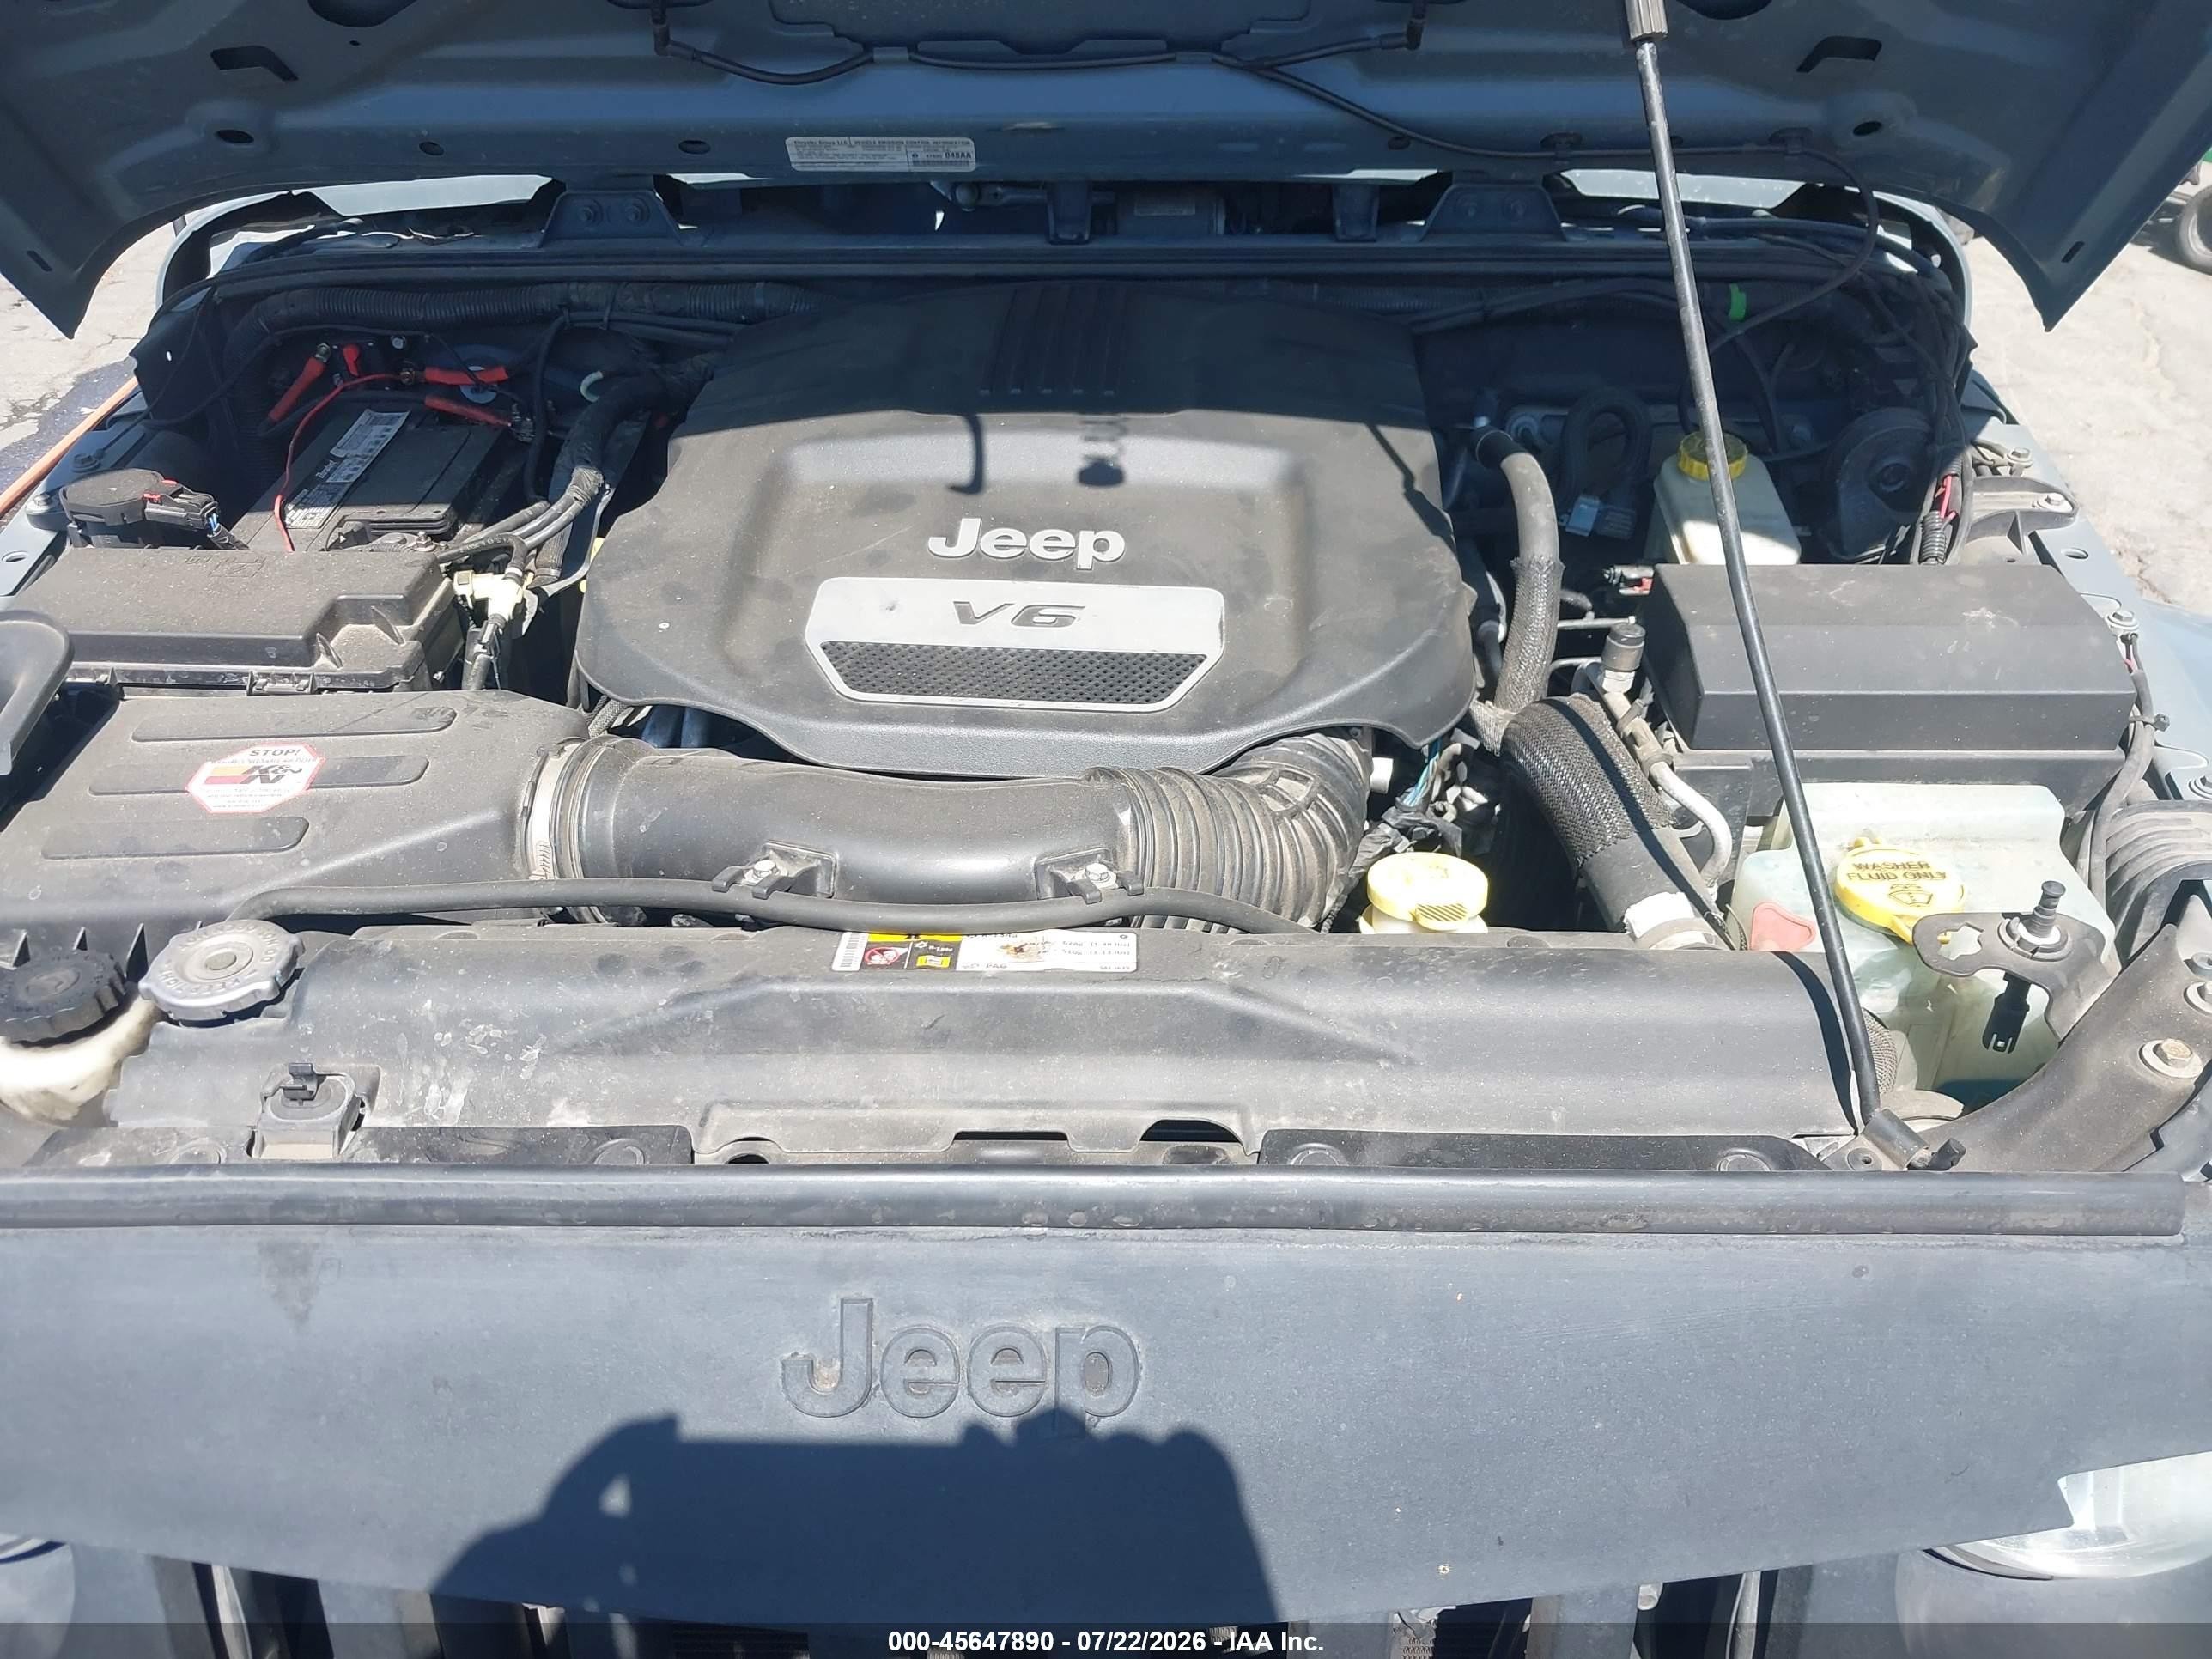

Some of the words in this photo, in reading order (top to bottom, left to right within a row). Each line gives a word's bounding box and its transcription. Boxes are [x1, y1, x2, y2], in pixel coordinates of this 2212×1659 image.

[927, 518, 1126, 570] Jeep
[952, 600, 1086, 628] V6
[249, 749, 301, 757] STOP!
[1852, 861, 1930, 871] WASHER
[1846, 872, 1899, 882] FLUID
[1902, 871, 1948, 882] ONLY
[781, 1297, 1139, 1439] Jeep
